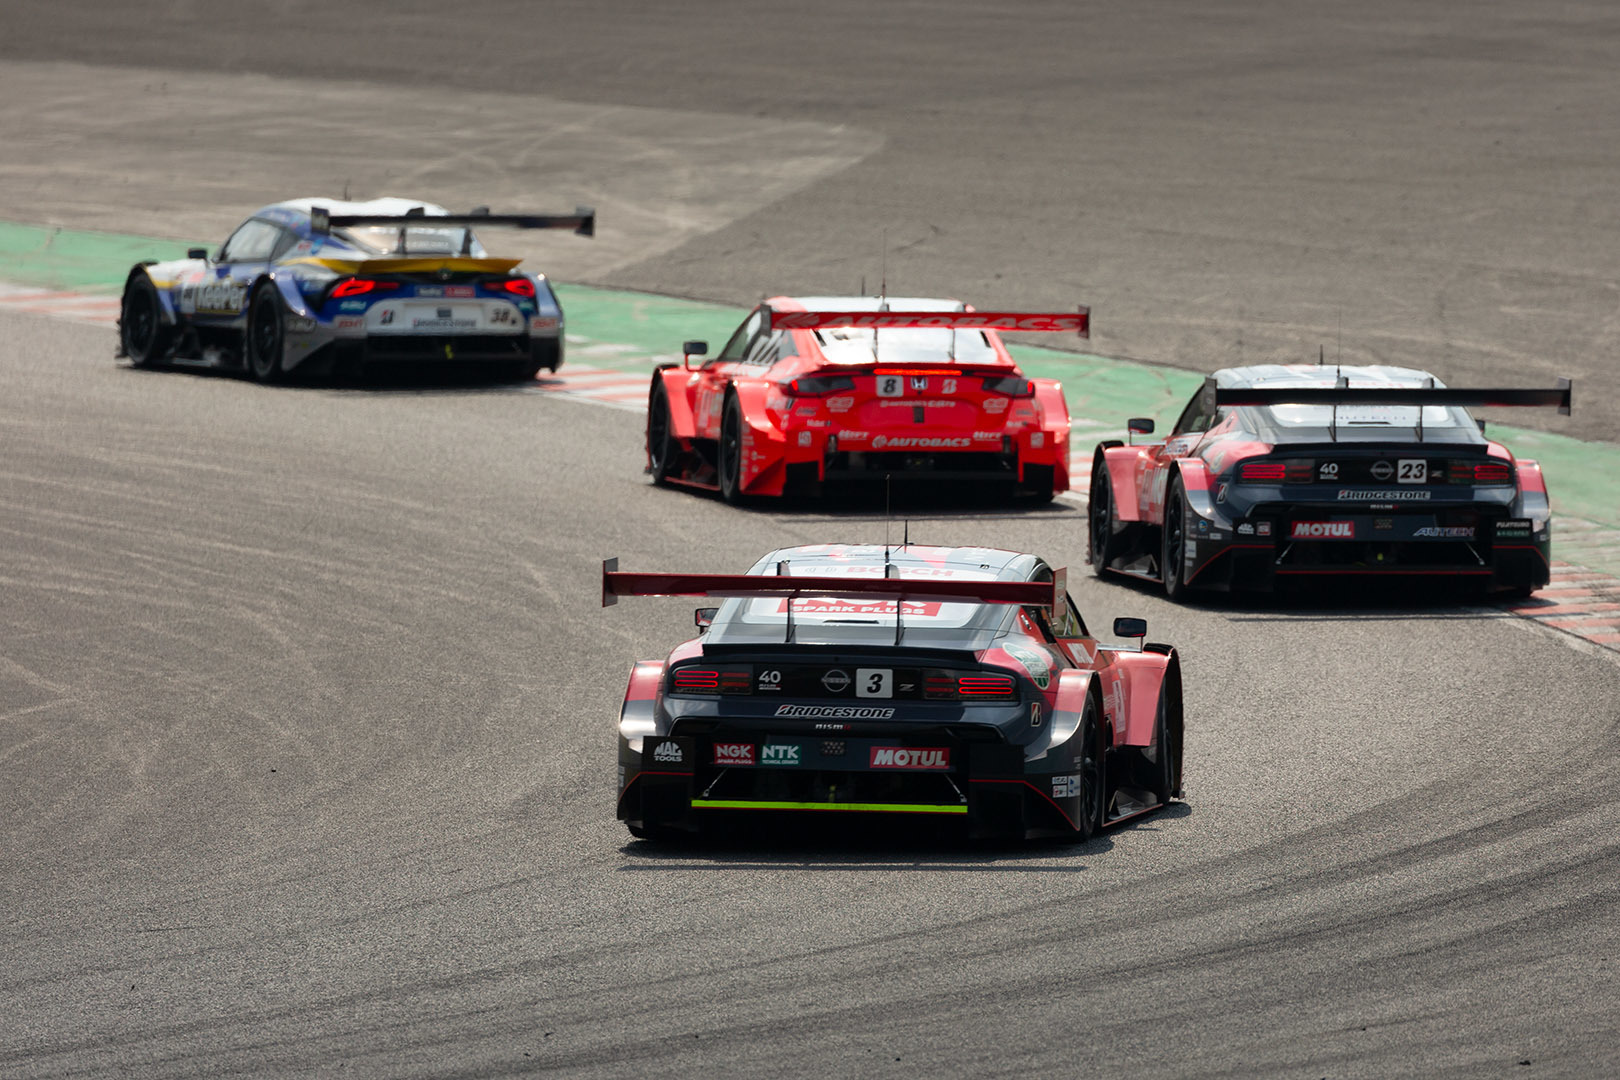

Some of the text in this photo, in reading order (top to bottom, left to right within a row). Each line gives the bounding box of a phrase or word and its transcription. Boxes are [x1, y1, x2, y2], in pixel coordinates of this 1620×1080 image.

[825, 315, 1079, 330] AUTOBACS
[883, 379, 896, 394] 8
[888, 437, 971, 447] AUTOBACS
[1320, 463, 1338, 473] 40
[1400, 463, 1425, 479] 23
[1337, 489, 1431, 500] BRIDGESTONE
[1294, 523, 1353, 536] MOTUL
[1412, 527, 1475, 537] AUTECH
[867, 606, 926, 614] PLUGS
[759, 670, 781, 683] 40
[867, 673, 883, 693] 3
[775, 705, 895, 719] BRIDGESTONE
[654, 741, 682, 755] MAC
[716, 745, 751, 757] NGK
[762, 745, 798, 758] NTK
[873, 750, 947, 766] MOTUL
